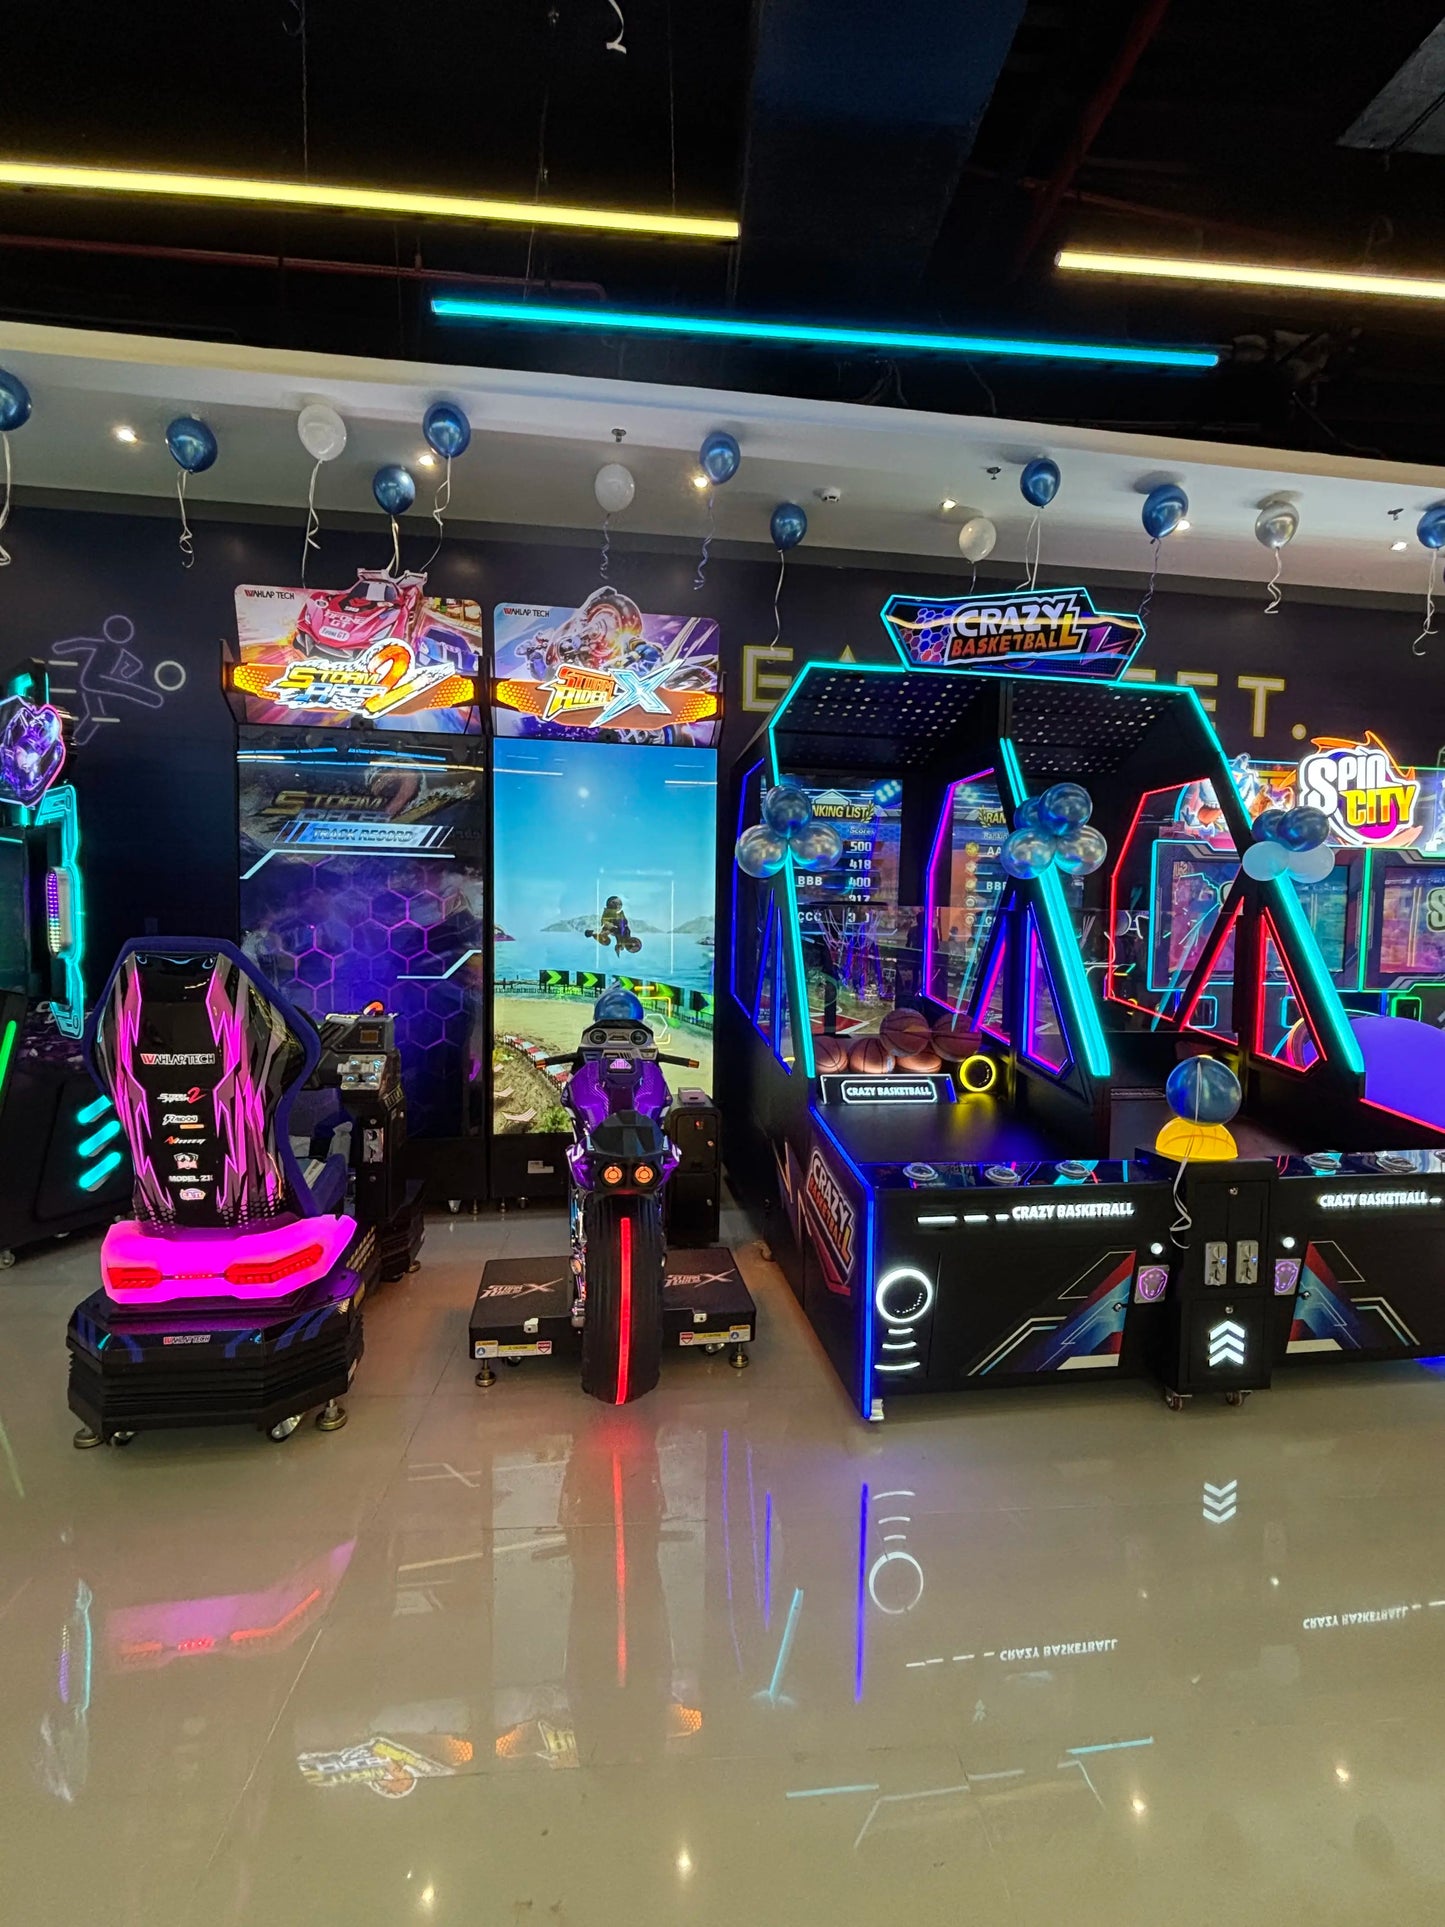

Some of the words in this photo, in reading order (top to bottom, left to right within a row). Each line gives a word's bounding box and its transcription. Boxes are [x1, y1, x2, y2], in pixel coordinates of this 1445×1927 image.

[275, 591, 295, 600] TECH
[531, 609, 550, 618] TECH
[956, 602, 1065, 637] CRAZY
[951, 613, 1080, 657] BASKETBALL
[278, 667, 381, 688] STORM
[294, 682, 388, 704] RACER
[547, 683, 608, 717] RIDER
[558, 665, 615, 692] STORM
[588, 658, 686, 728] X
[812, 804, 843, 819] NKING
[845, 804, 868, 819] LIST
[1339, 785, 1415, 827] CITY
[311, 827, 359, 841] TRACK
[360, 828, 415, 842] RECORD
[850, 841, 872, 852] 500
[849, 859, 872, 870] 418
[797, 875, 823, 886] BBB
[848, 876, 871, 887] 400
[187, 1053, 216, 1065] TECH
[846, 1086, 875, 1097] CRAZY
[877, 1086, 932, 1097] BASKETBALL
[813, 1157, 850, 1234] CRAZY
[1319, 1194, 1358, 1208] CRAZY
[1359, 1191, 1428, 1206] BASKETBALL
[1012, 1205, 1055, 1220] CRAZY
[1056, 1202, 1135, 1219] BASKETBALL
